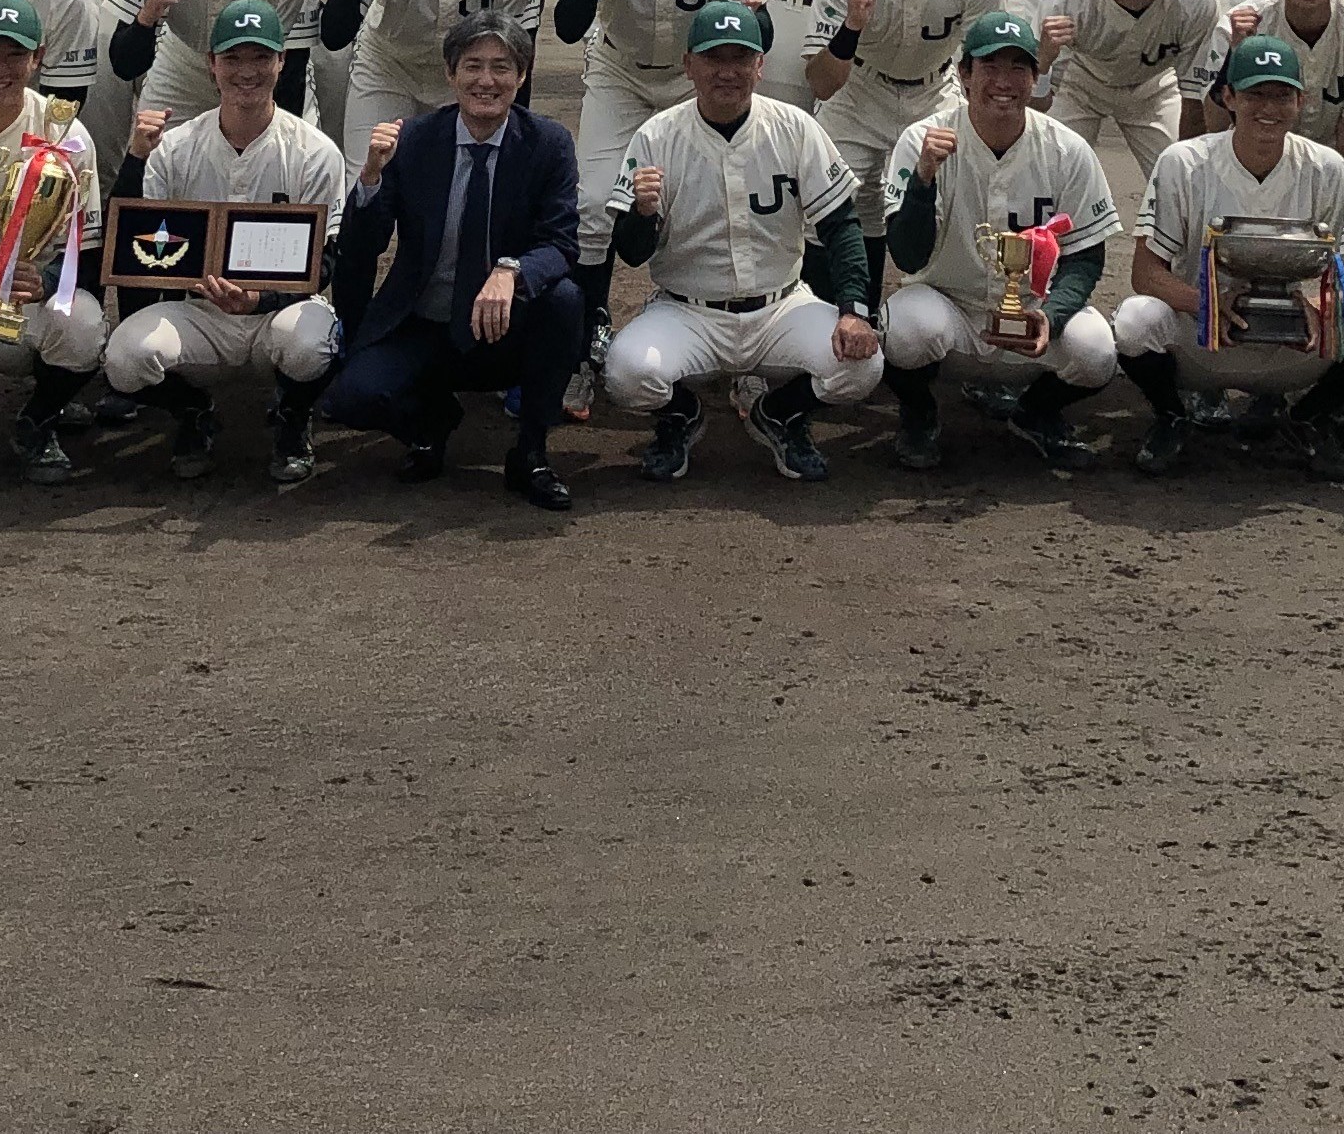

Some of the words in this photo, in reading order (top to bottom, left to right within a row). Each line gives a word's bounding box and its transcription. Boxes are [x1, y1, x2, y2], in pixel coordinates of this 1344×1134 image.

[234, 13, 262, 29] JR
[714, 16, 742, 31] JR
[995, 21, 1021, 38] JR
[1255, 51, 1282, 66] JR
[1092, 198, 1108, 217] EAST
